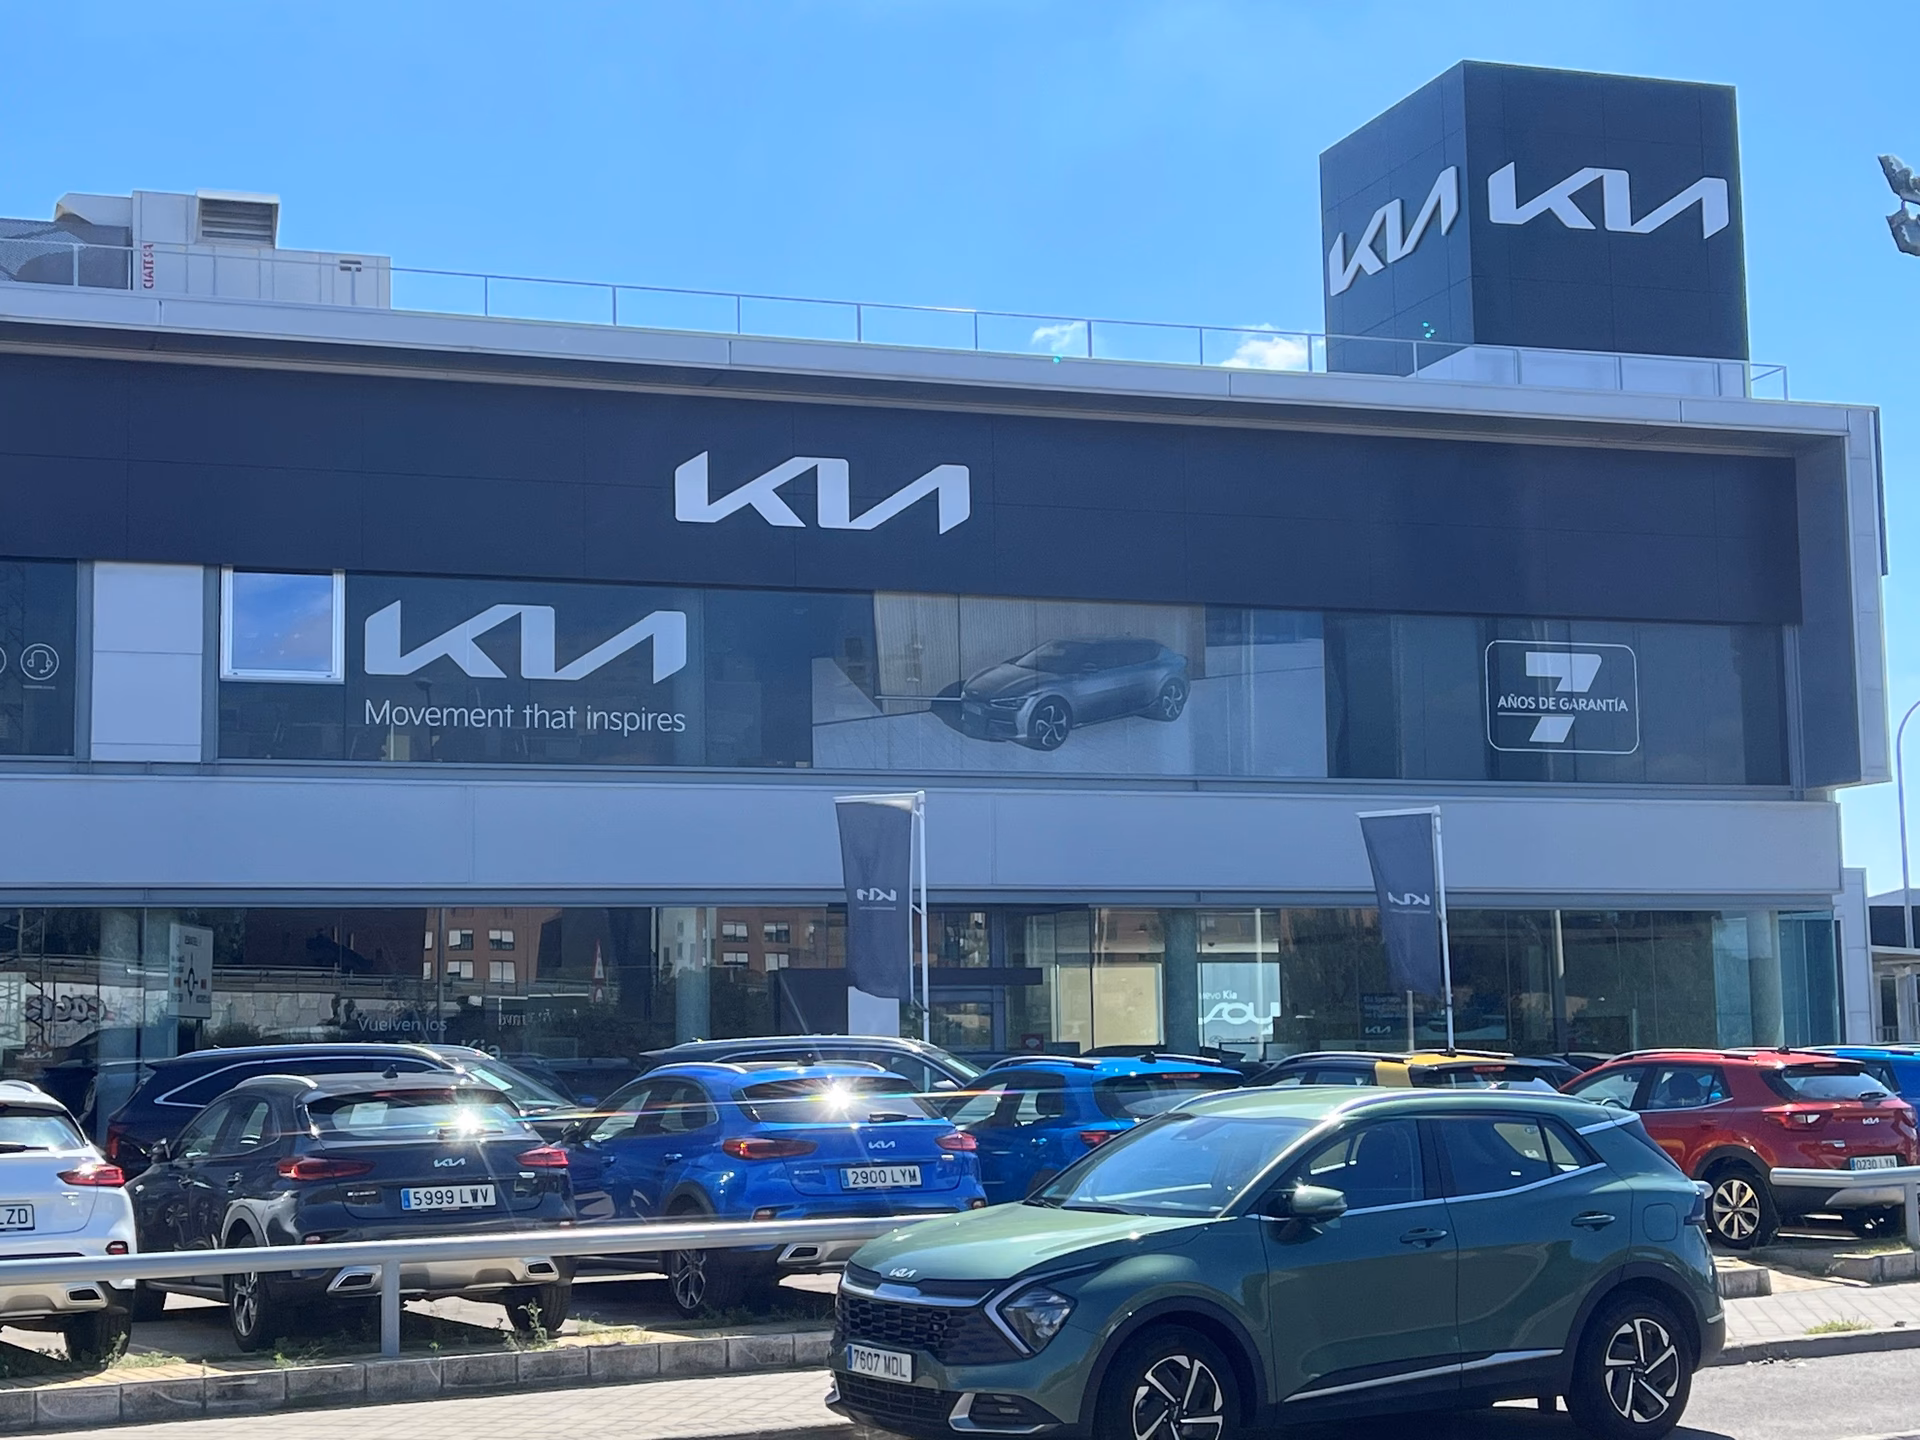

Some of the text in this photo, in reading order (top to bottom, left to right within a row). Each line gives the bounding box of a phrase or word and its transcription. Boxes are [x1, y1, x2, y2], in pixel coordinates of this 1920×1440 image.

[1487, 161, 1730, 239] KIA
[1329, 165, 1458, 297] KIA
[143, 244, 154, 289] CIATESA
[674, 450, 970, 535] KIA
[364, 600, 687, 684] KIA
[1497, 693, 1629, 712] AÑOS DE GARANTÍA
[364, 698, 687, 737] Movement that inspires
[1223, 990, 1238, 1000] Kia
[357, 1017, 447, 1032] Vuelven los
[1862, 1117, 1880, 1125] KIA
[868, 1140, 896, 1149] KIA
[433, 1157, 466, 1168] KIA
[851, 1168, 918, 1185] 2900 LYM
[413, 1188, 489, 1206] 5999 LWV
[0, 1208, 28, 1225] ZD
[888, 1267, 918, 1279] KIA
[853, 1349, 908, 1378] 7607 MDL
